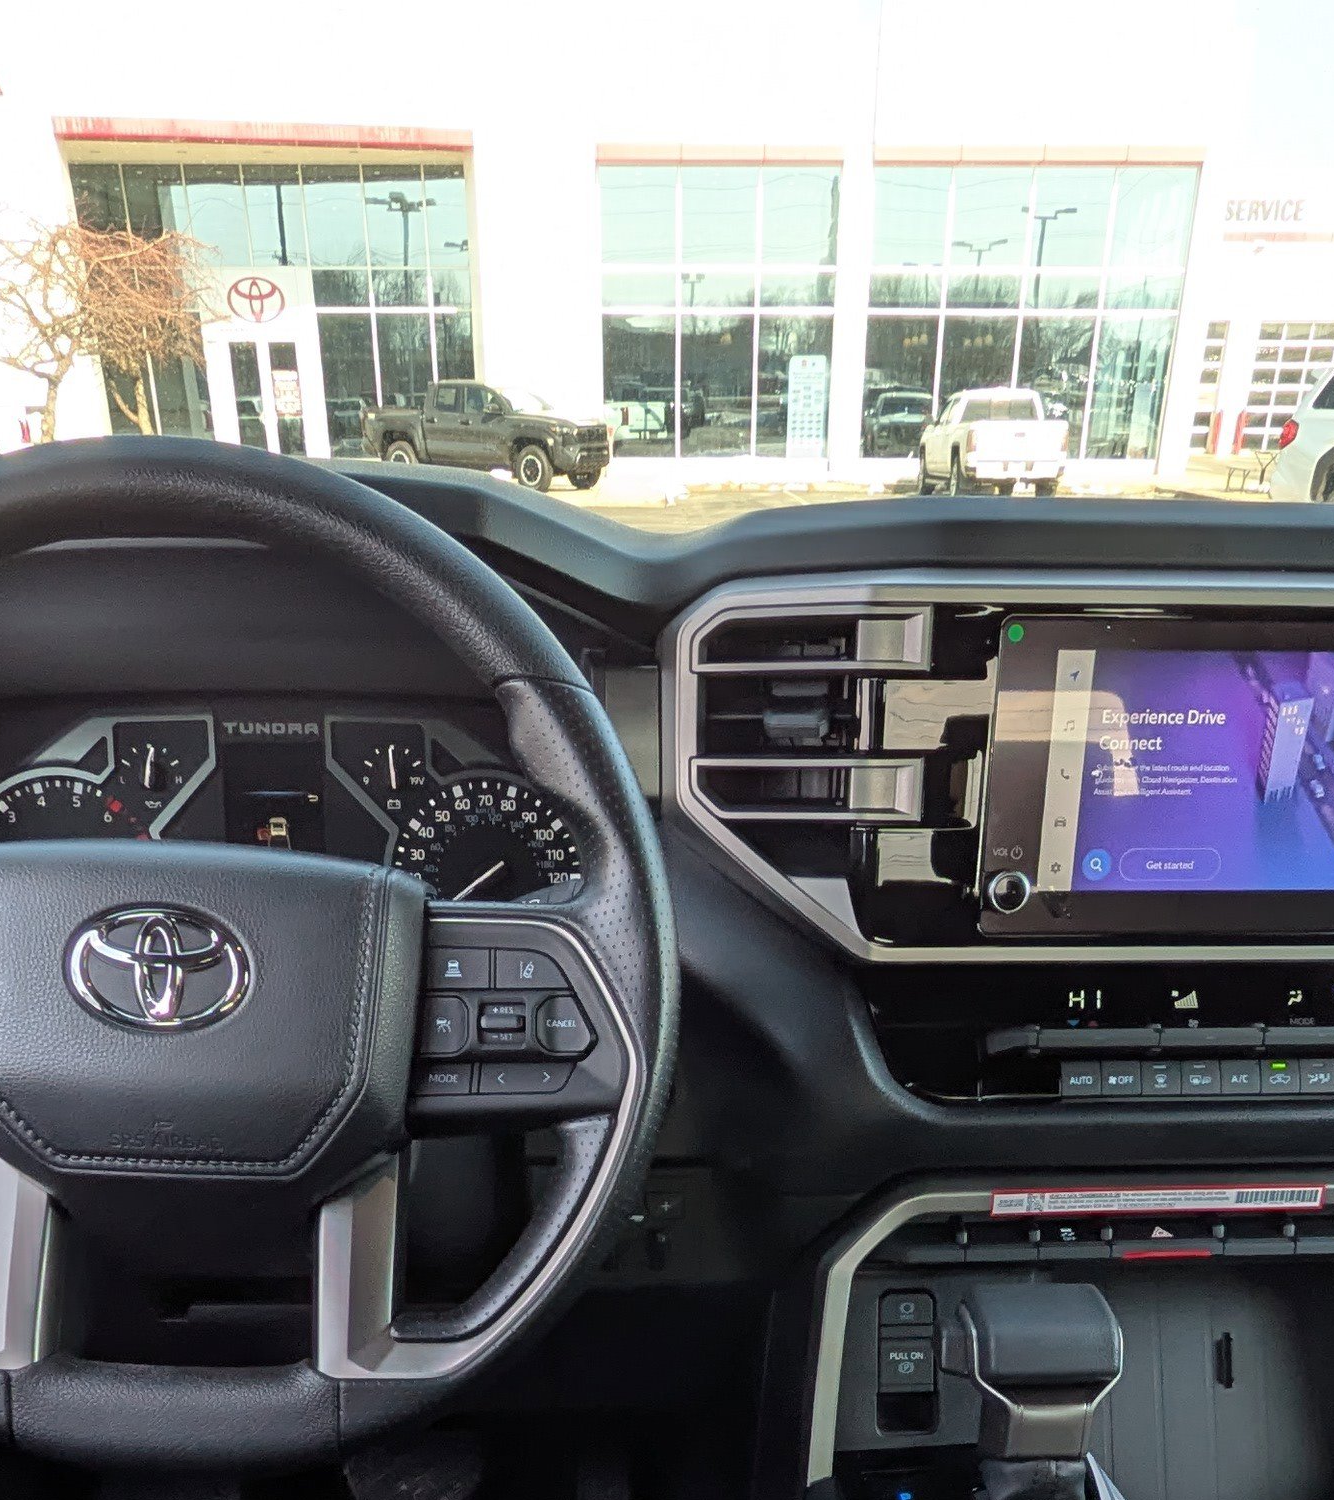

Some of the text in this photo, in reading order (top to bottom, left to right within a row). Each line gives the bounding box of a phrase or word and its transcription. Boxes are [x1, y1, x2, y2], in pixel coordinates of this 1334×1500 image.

[1225, 199, 1305, 222] SERVICE
[1102, 709, 1227, 728] Experience Drive
[223, 722, 319, 735] TUNDRA
[1099, 735, 1163, 751] Connect
[175, 776, 183, 784] H
[363, 776, 370, 785] 9
[409, 776, 425, 785] 19V
[36, 796, 46, 807] 4
[72, 796, 81, 807] 5
[454, 798, 471, 811] 60
[478, 794, 494, 807] 70
[500, 799, 517, 811] 80
[8, 812, 16, 823] 3
[104, 812, 112, 823] 6
[434, 810, 451, 822] 50
[521, 811, 538, 824] 90
[418, 827, 435, 839] 40
[533, 829, 555, 841] 100
[409, 848, 426, 861] 30
[546, 849, 565, 861] 110
[1145, 860, 1194, 870] Get started
[548, 872, 569, 884] 120
[546, 1019, 577, 1028] CANCEL
[1289, 1017, 1315, 1026] MODE
[428, 1073, 458, 1083] MODE
[1069, 1075, 1093, 1085] AUTO
[1117, 1075, 1134, 1084] OFF
[1231, 1074, 1249, 1084] A/C
[889, 1351, 924, 1360] PULL ON
